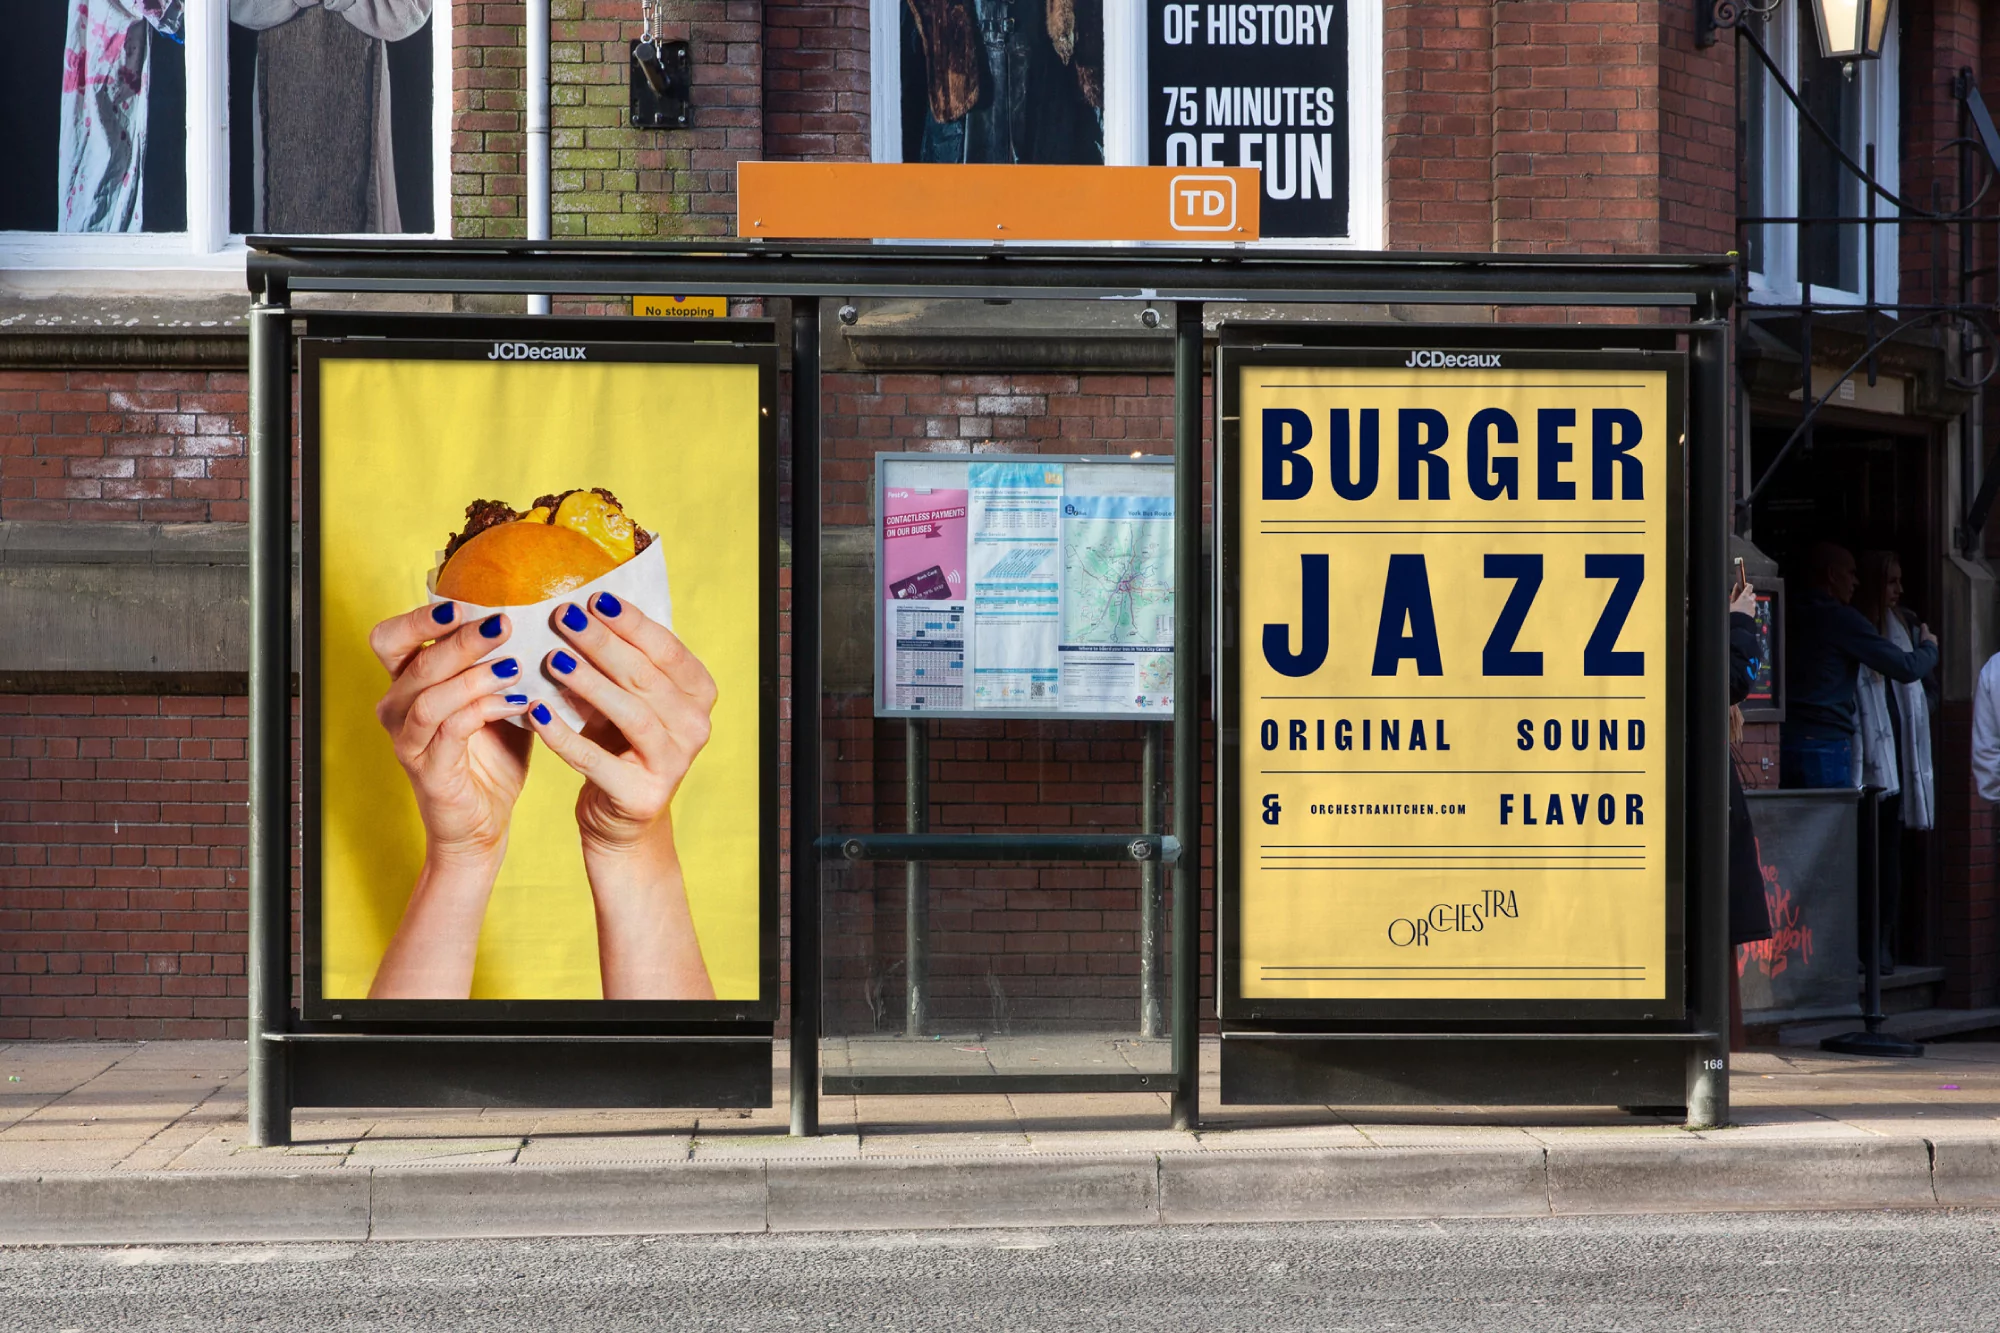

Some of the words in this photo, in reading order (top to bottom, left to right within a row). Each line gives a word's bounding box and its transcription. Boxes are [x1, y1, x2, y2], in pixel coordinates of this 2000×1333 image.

[1163, 4, 1199, 45] OF
[1207, 4, 1334, 45] HISTORY
[1162, 87, 1198, 126] 75
[1205, 87, 1335, 126] MINUTES
[1239, 133, 1333, 200] FUN
[1180, 190, 1225, 216] TD
[645, 306, 661, 316] No
[665, 306, 715, 318] stopping
[487, 343, 587, 360] JCDecaux
[1405, 350, 1502, 368] JCDecaux
[1262, 408, 1645, 501] BURGER
[887, 513, 930, 525] CONTACTLESS
[932, 508, 964, 520] PAYMENTS
[887, 529, 896, 537] ON
[897, 527, 910, 536] OUR
[911, 524, 932, 535] BUSES
[1262, 554, 1645, 677] JAZZ
[1261, 719, 1451, 751] ORIGINAL
[1517, 719, 1646, 751] SOUND
[1262, 793, 1282, 825] &
[1310, 804, 1467, 815] ORCHESTRAKITCHEN.COM
[1500, 793, 1645, 825] FLAVOR
[1388, 890, 1519, 947] ORCHESTRA
[1703, 1059, 1723, 1070] 168
